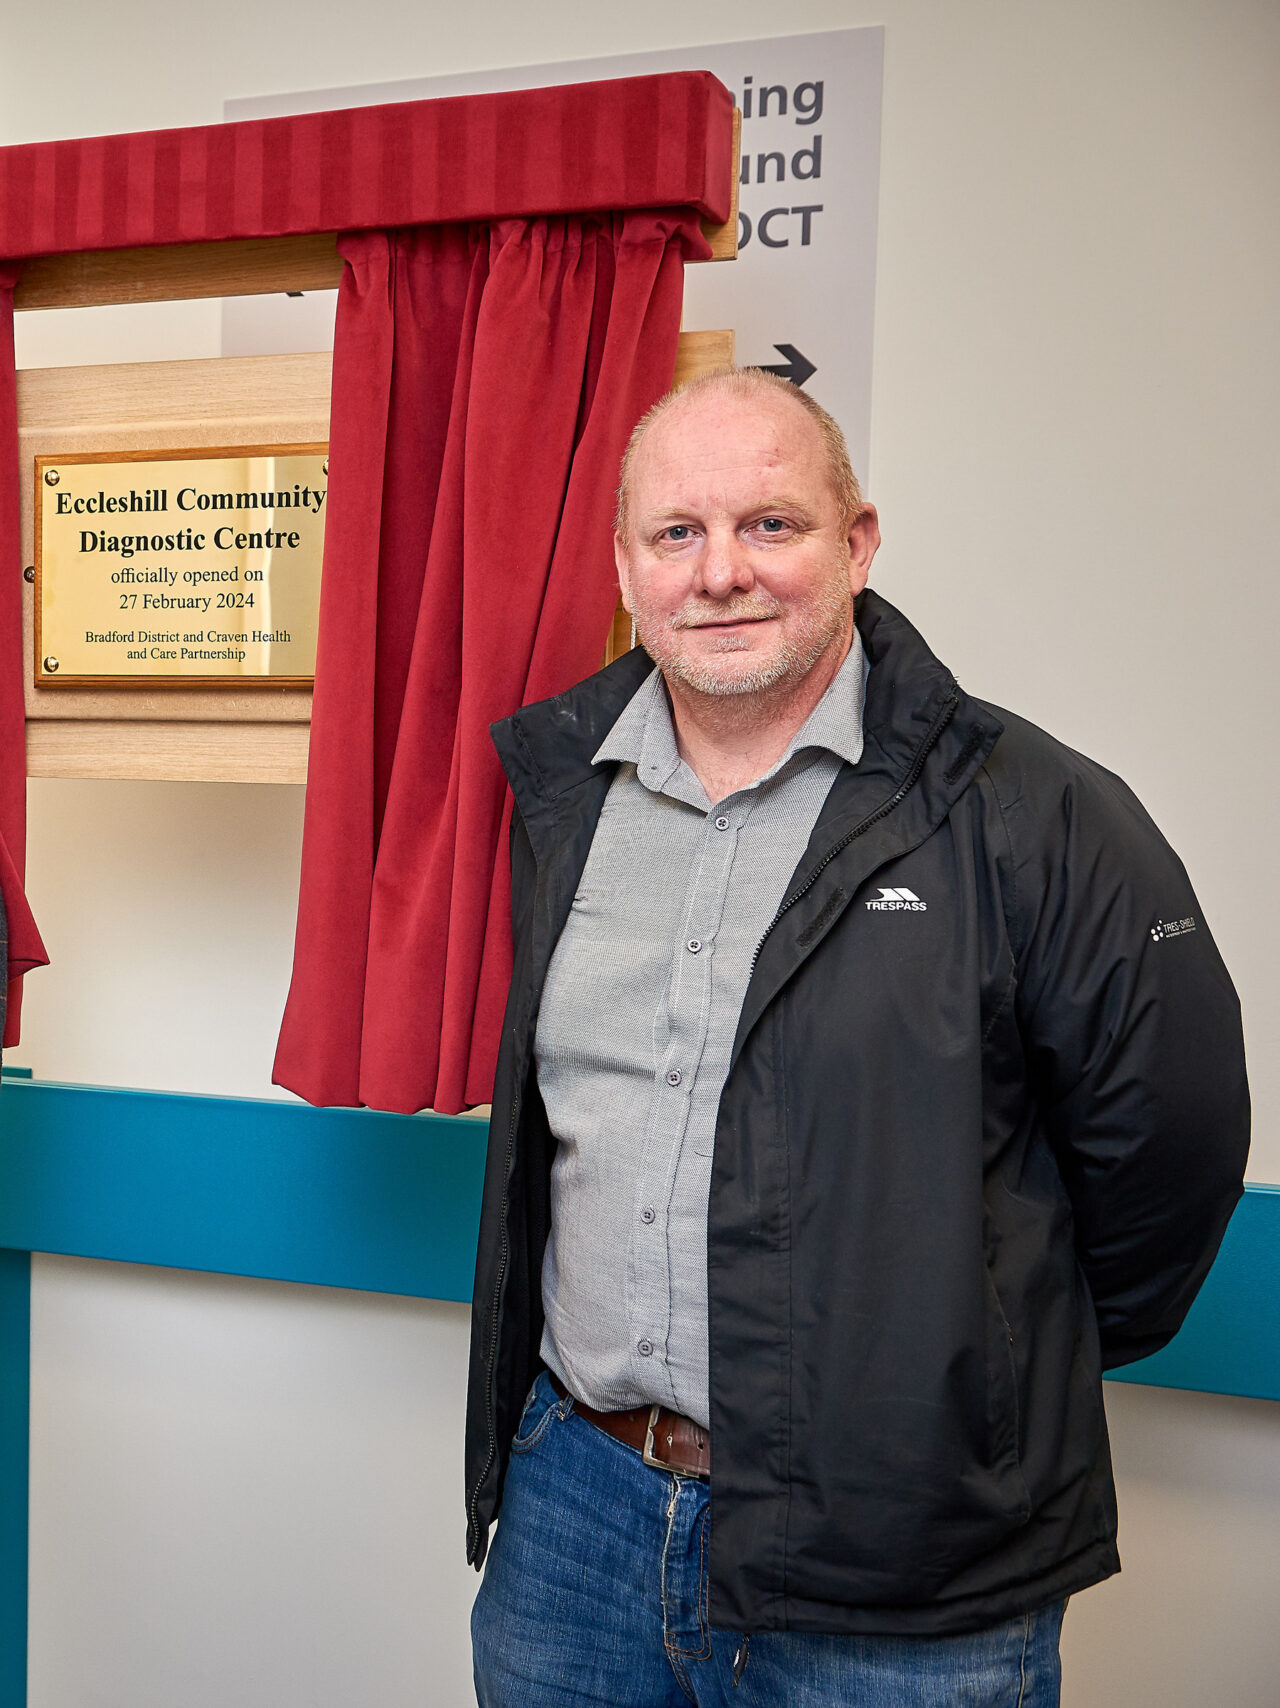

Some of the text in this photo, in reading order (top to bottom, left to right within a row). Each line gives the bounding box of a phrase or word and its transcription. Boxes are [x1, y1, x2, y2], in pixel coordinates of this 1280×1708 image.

[56, 485, 327, 514] Eccleshill Community
[79, 527, 300, 558] Diagnostic Centre
[111, 566, 263, 586] officially opened on
[120, 593, 254, 612] 27 February 2024
[86, 630, 290, 642] Bradford District and Craven Health
[128, 648, 245, 662] and Care Partnership
[865, 902, 927, 912] TRESPASS
